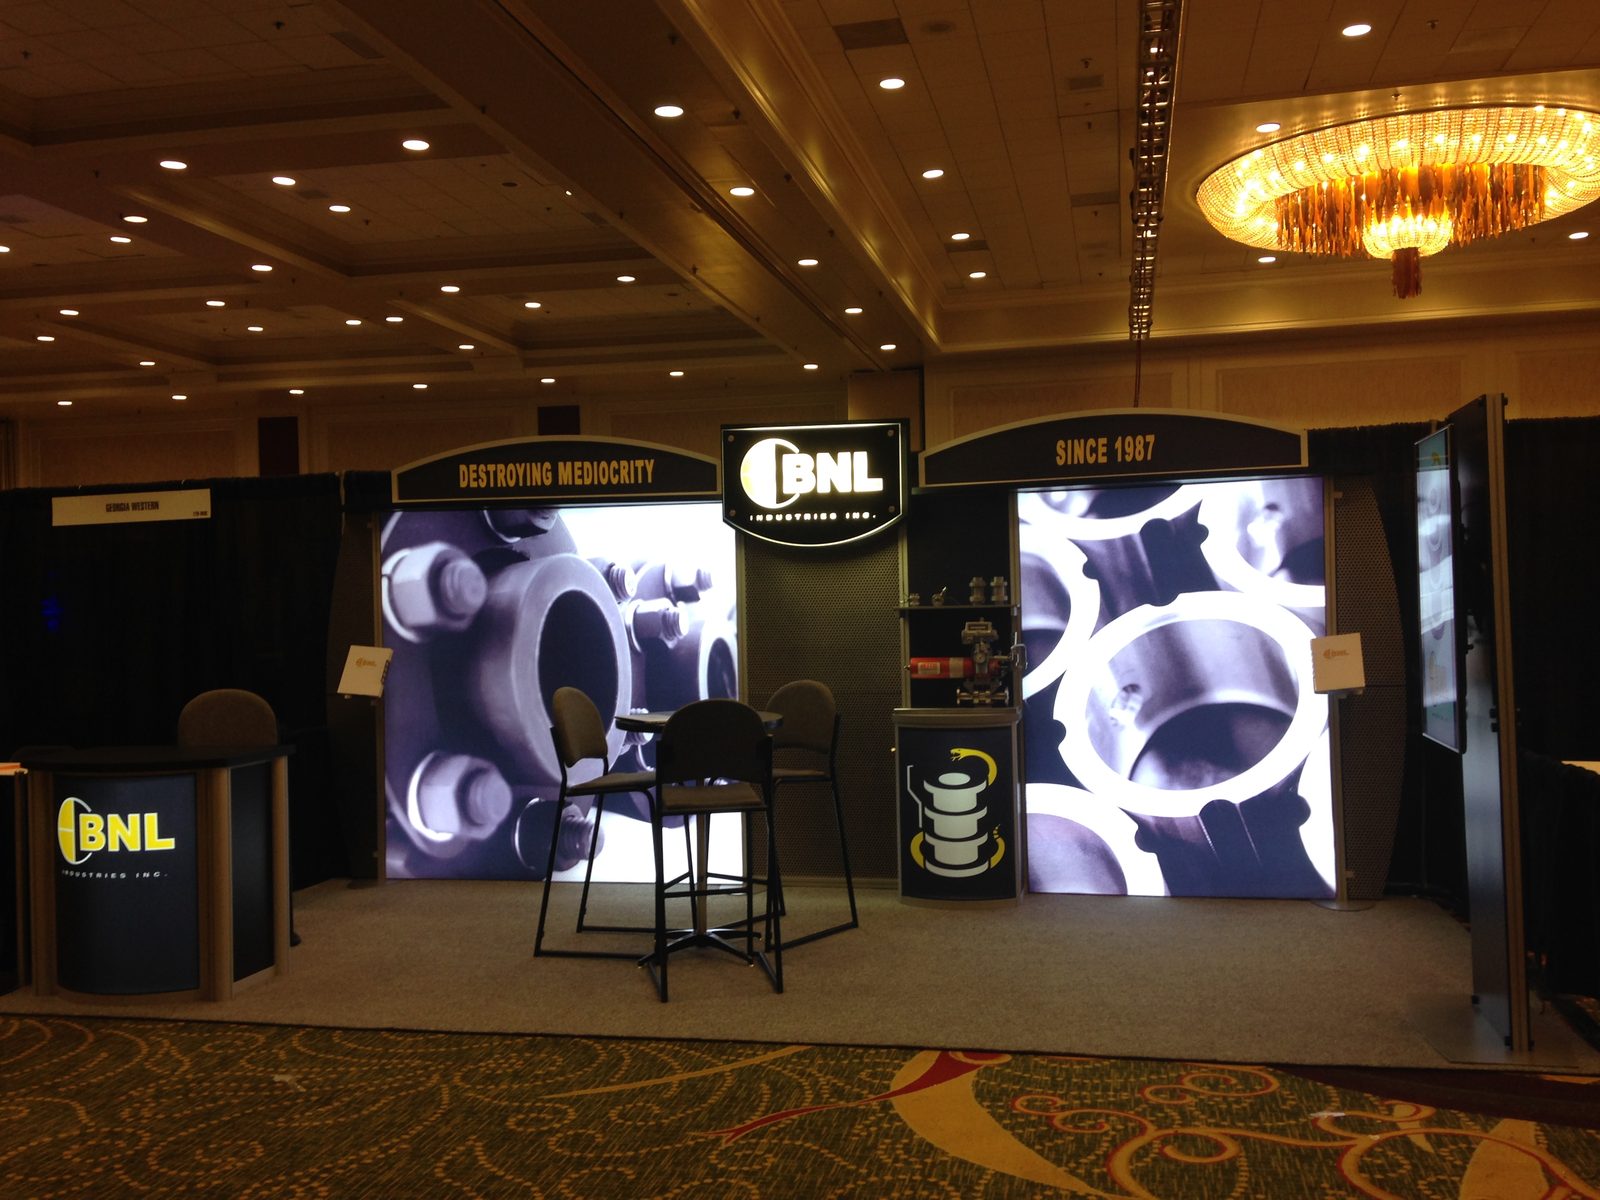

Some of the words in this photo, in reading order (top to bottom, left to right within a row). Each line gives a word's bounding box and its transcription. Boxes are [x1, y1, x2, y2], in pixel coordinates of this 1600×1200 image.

[1056, 437, 1108, 466] SINCE
[1114, 434, 1156, 463] 1987
[459, 461, 552, 488] DESTROYING
[558, 459, 655, 486] MEDIOCRITY
[781, 451, 884, 495] BNL
[105, 502, 130, 513] GEORGIA
[131, 501, 160, 511] WESTERN
[749, 512, 838, 522] INDUSTRIES
[79, 812, 176, 852] BNL
